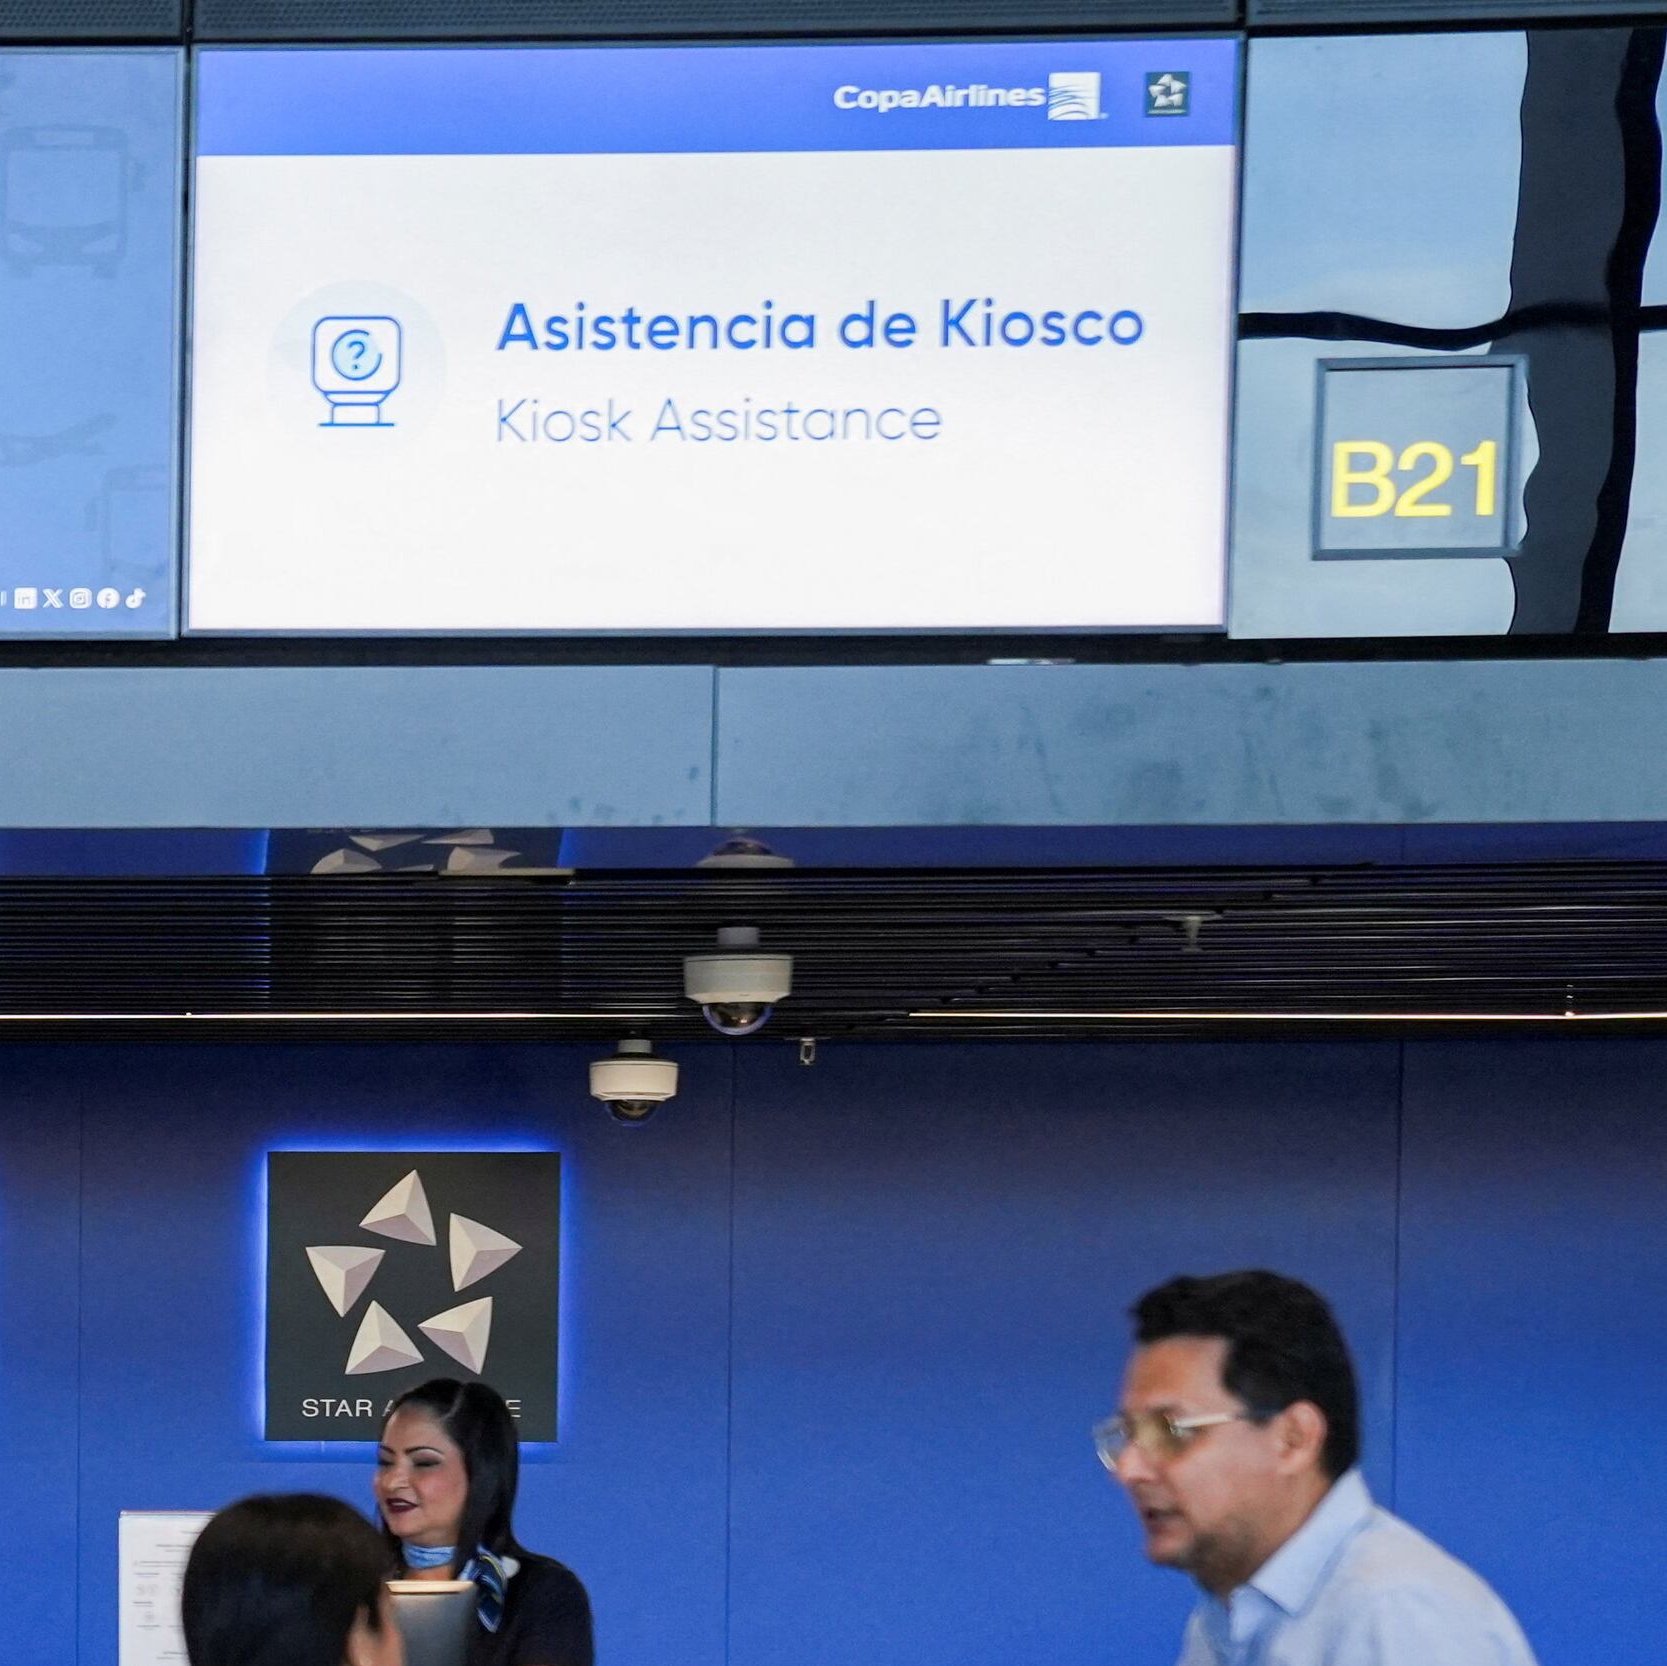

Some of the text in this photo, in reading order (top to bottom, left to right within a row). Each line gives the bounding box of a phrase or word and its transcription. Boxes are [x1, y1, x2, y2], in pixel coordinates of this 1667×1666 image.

[833, 84, 1047, 113] CopaAirlines
[497, 297, 1145, 350] Asistencia de Kiosco
[497, 397, 942, 443] Kiosk Assistance
[1330, 441, 1497, 518] B21
[302, 1399, 372, 1417] STAR
